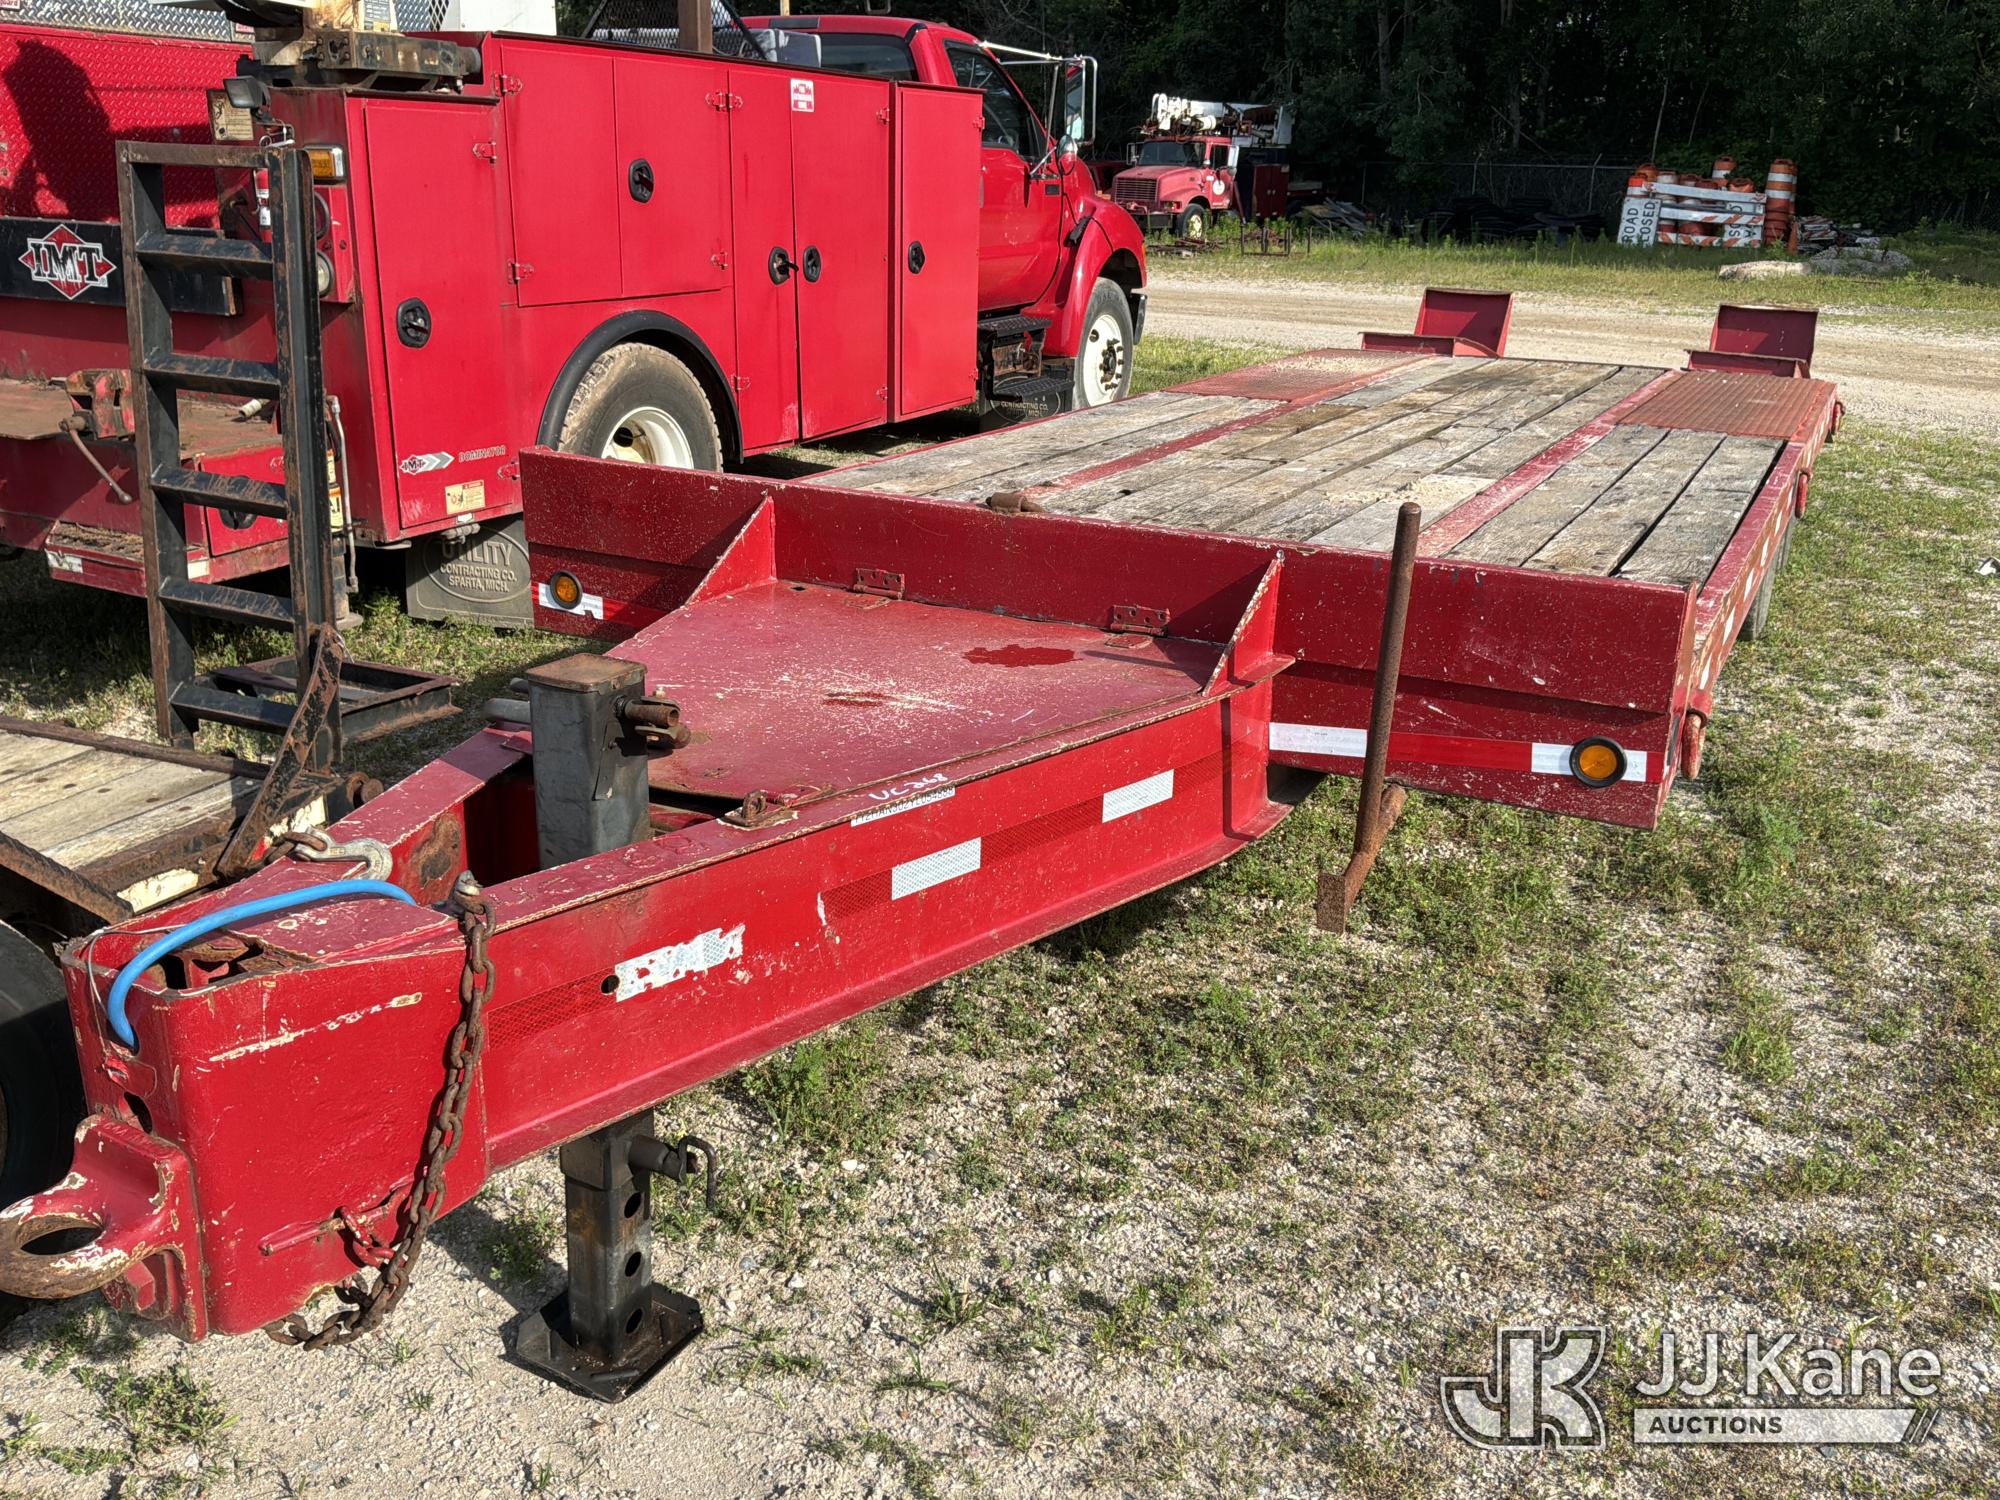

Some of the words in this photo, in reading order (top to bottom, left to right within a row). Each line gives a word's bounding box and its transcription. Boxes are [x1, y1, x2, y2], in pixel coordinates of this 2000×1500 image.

[1621, 207, 1639, 244] ROAD
[1640, 201, 1656, 248] LOSED
[30, 242, 102, 282] IMT
[459, 445, 506, 462] DOMINATOR
[440, 563, 500, 580] CONTRACTING
[501, 569, 518, 582] CO.
